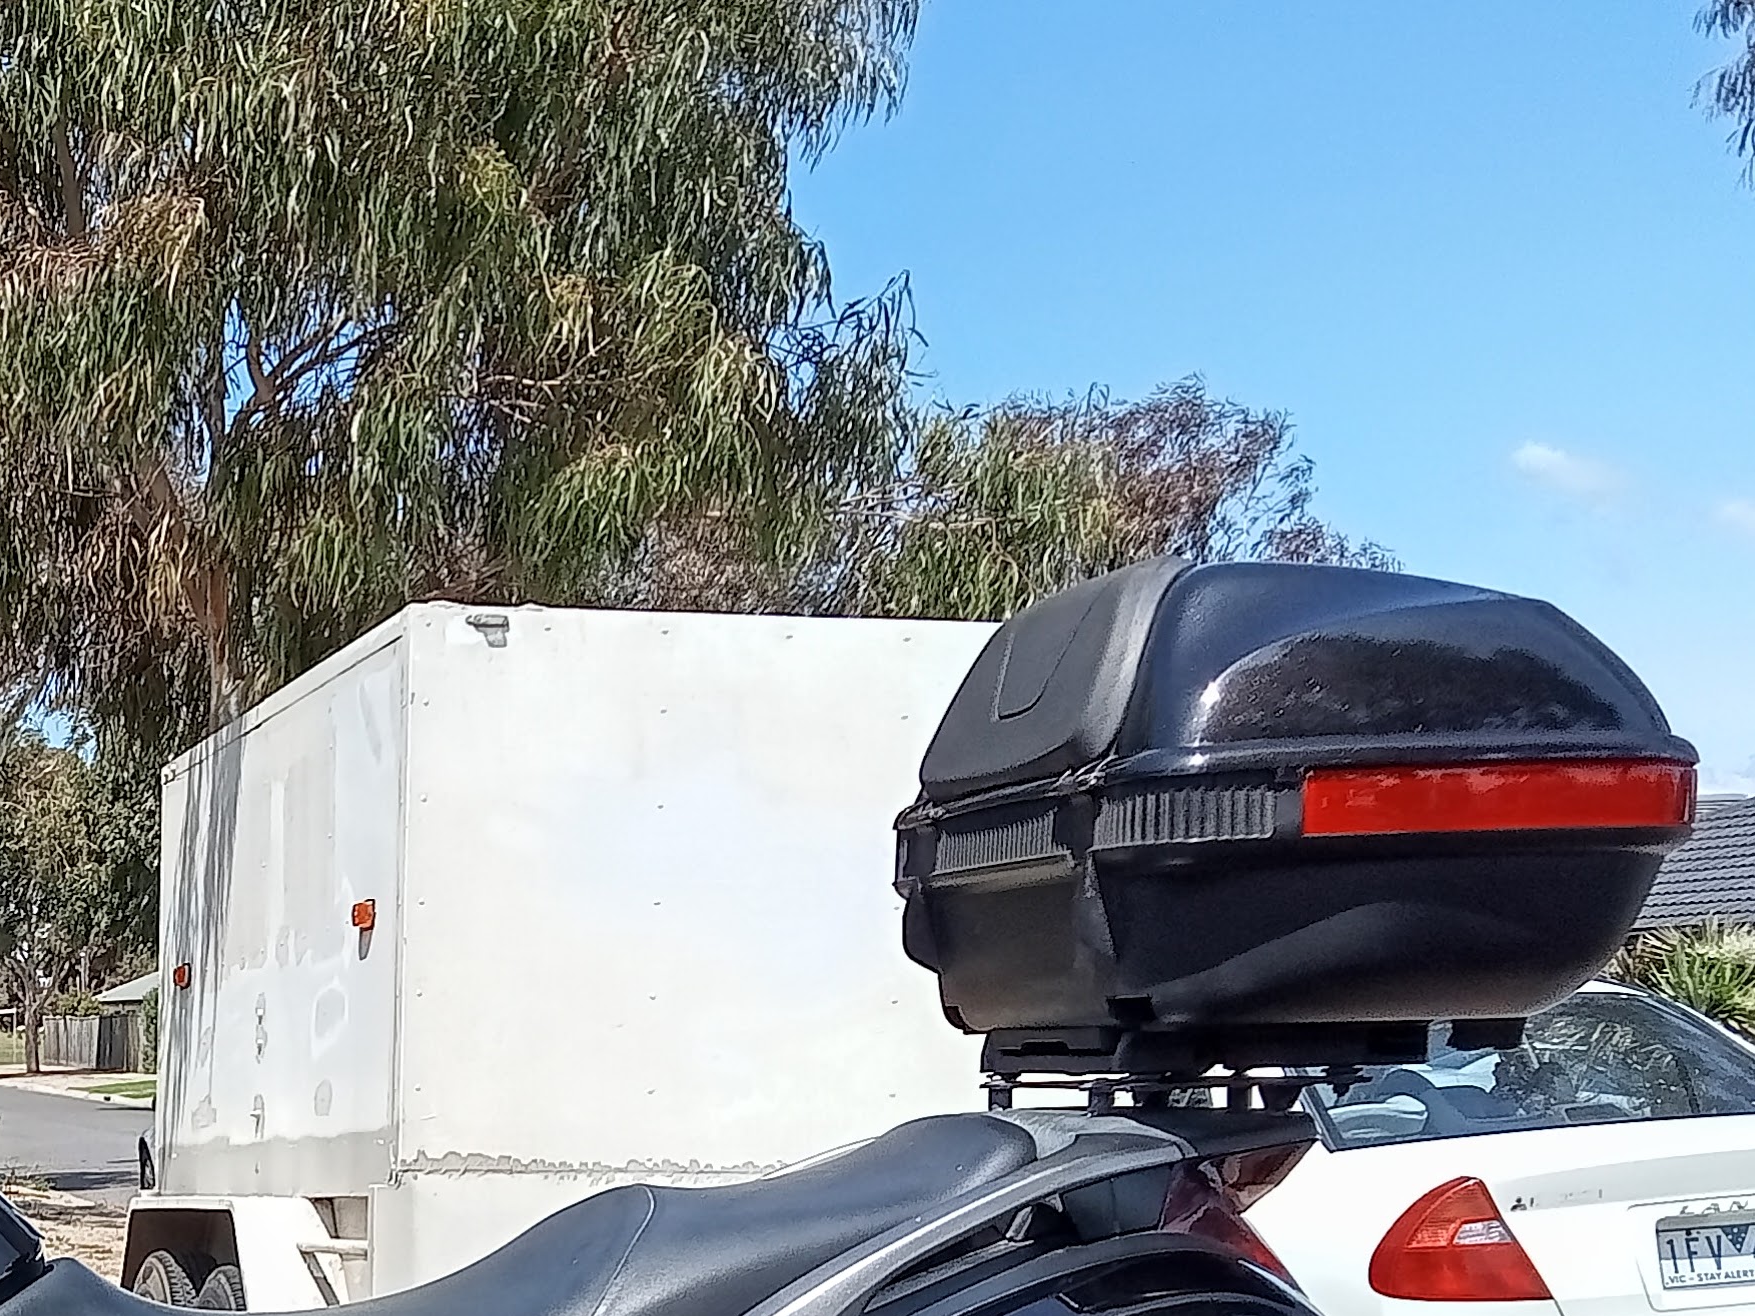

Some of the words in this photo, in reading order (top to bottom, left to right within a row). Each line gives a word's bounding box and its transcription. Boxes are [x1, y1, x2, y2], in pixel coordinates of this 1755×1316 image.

[1666, 1235, 1722, 1274] 1FV
[1668, 1275, 1686, 1284] VIC
[1697, 1272, 1721, 1282] STAY
[1724, 1269, 1755, 1279] ALERT
